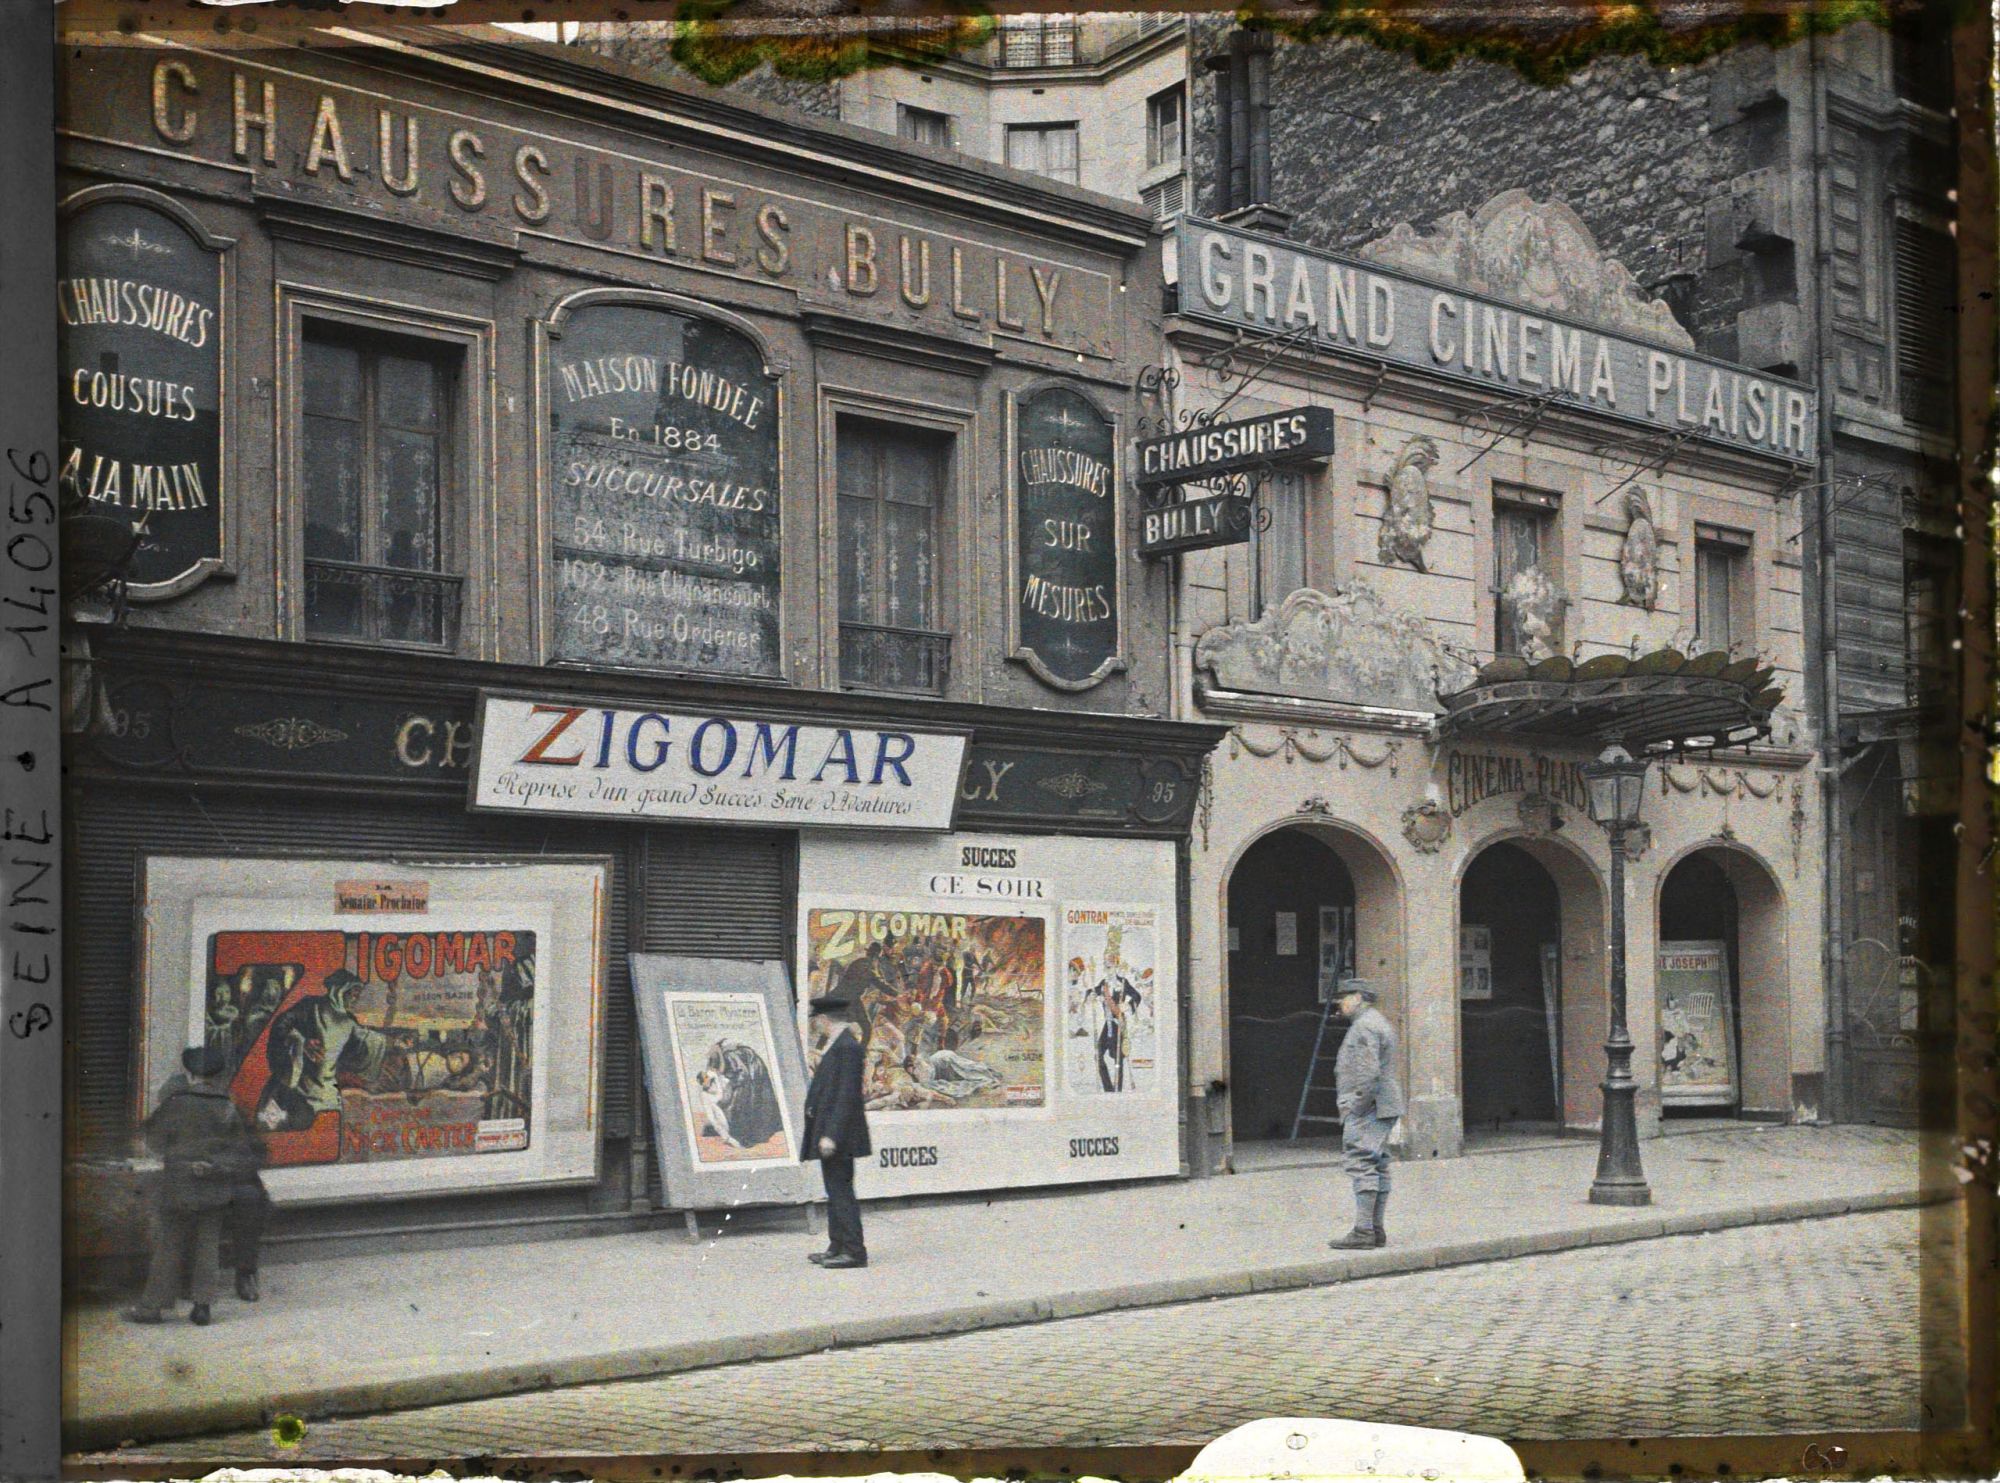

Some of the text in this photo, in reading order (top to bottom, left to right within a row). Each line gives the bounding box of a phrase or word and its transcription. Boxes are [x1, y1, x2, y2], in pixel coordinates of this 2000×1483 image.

[152, 58, 1062, 336] CHAUSSURES BULLY
[58, 278, 214, 348] CHAUSSURES
[1202, 232, 1394, 350] GRAND
[1429, 293, 1616, 409] CINEMA
[73, 368, 196, 421] COUSUES
[561, 356, 764, 430] MAISON FONDÉE
[610, 417, 721, 453] En 1884
[1143, 414, 1307, 475] CHAUSSURES
[88, 454, 122, 506] LA
[131, 461, 208, 510] MAIN
[565, 462, 767, 511] SUCCURSALES
[1021, 446, 1110, 498] CHAUSSURES
[1044, 518, 1092, 551] SUR
[1146, 501, 1224, 544] BULLY
[624, 522, 665, 555] Rue
[674, 527, 758, 574] Turbigo
[1021, 573, 1110, 623] MESURES
[574, 604, 762, 650] 48 Rue Ordener
[513, 703, 916, 787] ZIGOMAR
[493, 771, 577, 806] Reprise
[631, 783, 697, 814] grand
[1152, 781, 1177, 804] 95
[961, 846, 1017, 869] SUCCES
[930, 876, 1044, 899] CE SOIR
[819, 911, 967, 960] ZIGOMAR
[1067, 910, 1108, 924] GONTRAN
[879, 1146, 938, 1168] SUCCES
[1069, 1136, 1119, 1158] SUCCES
